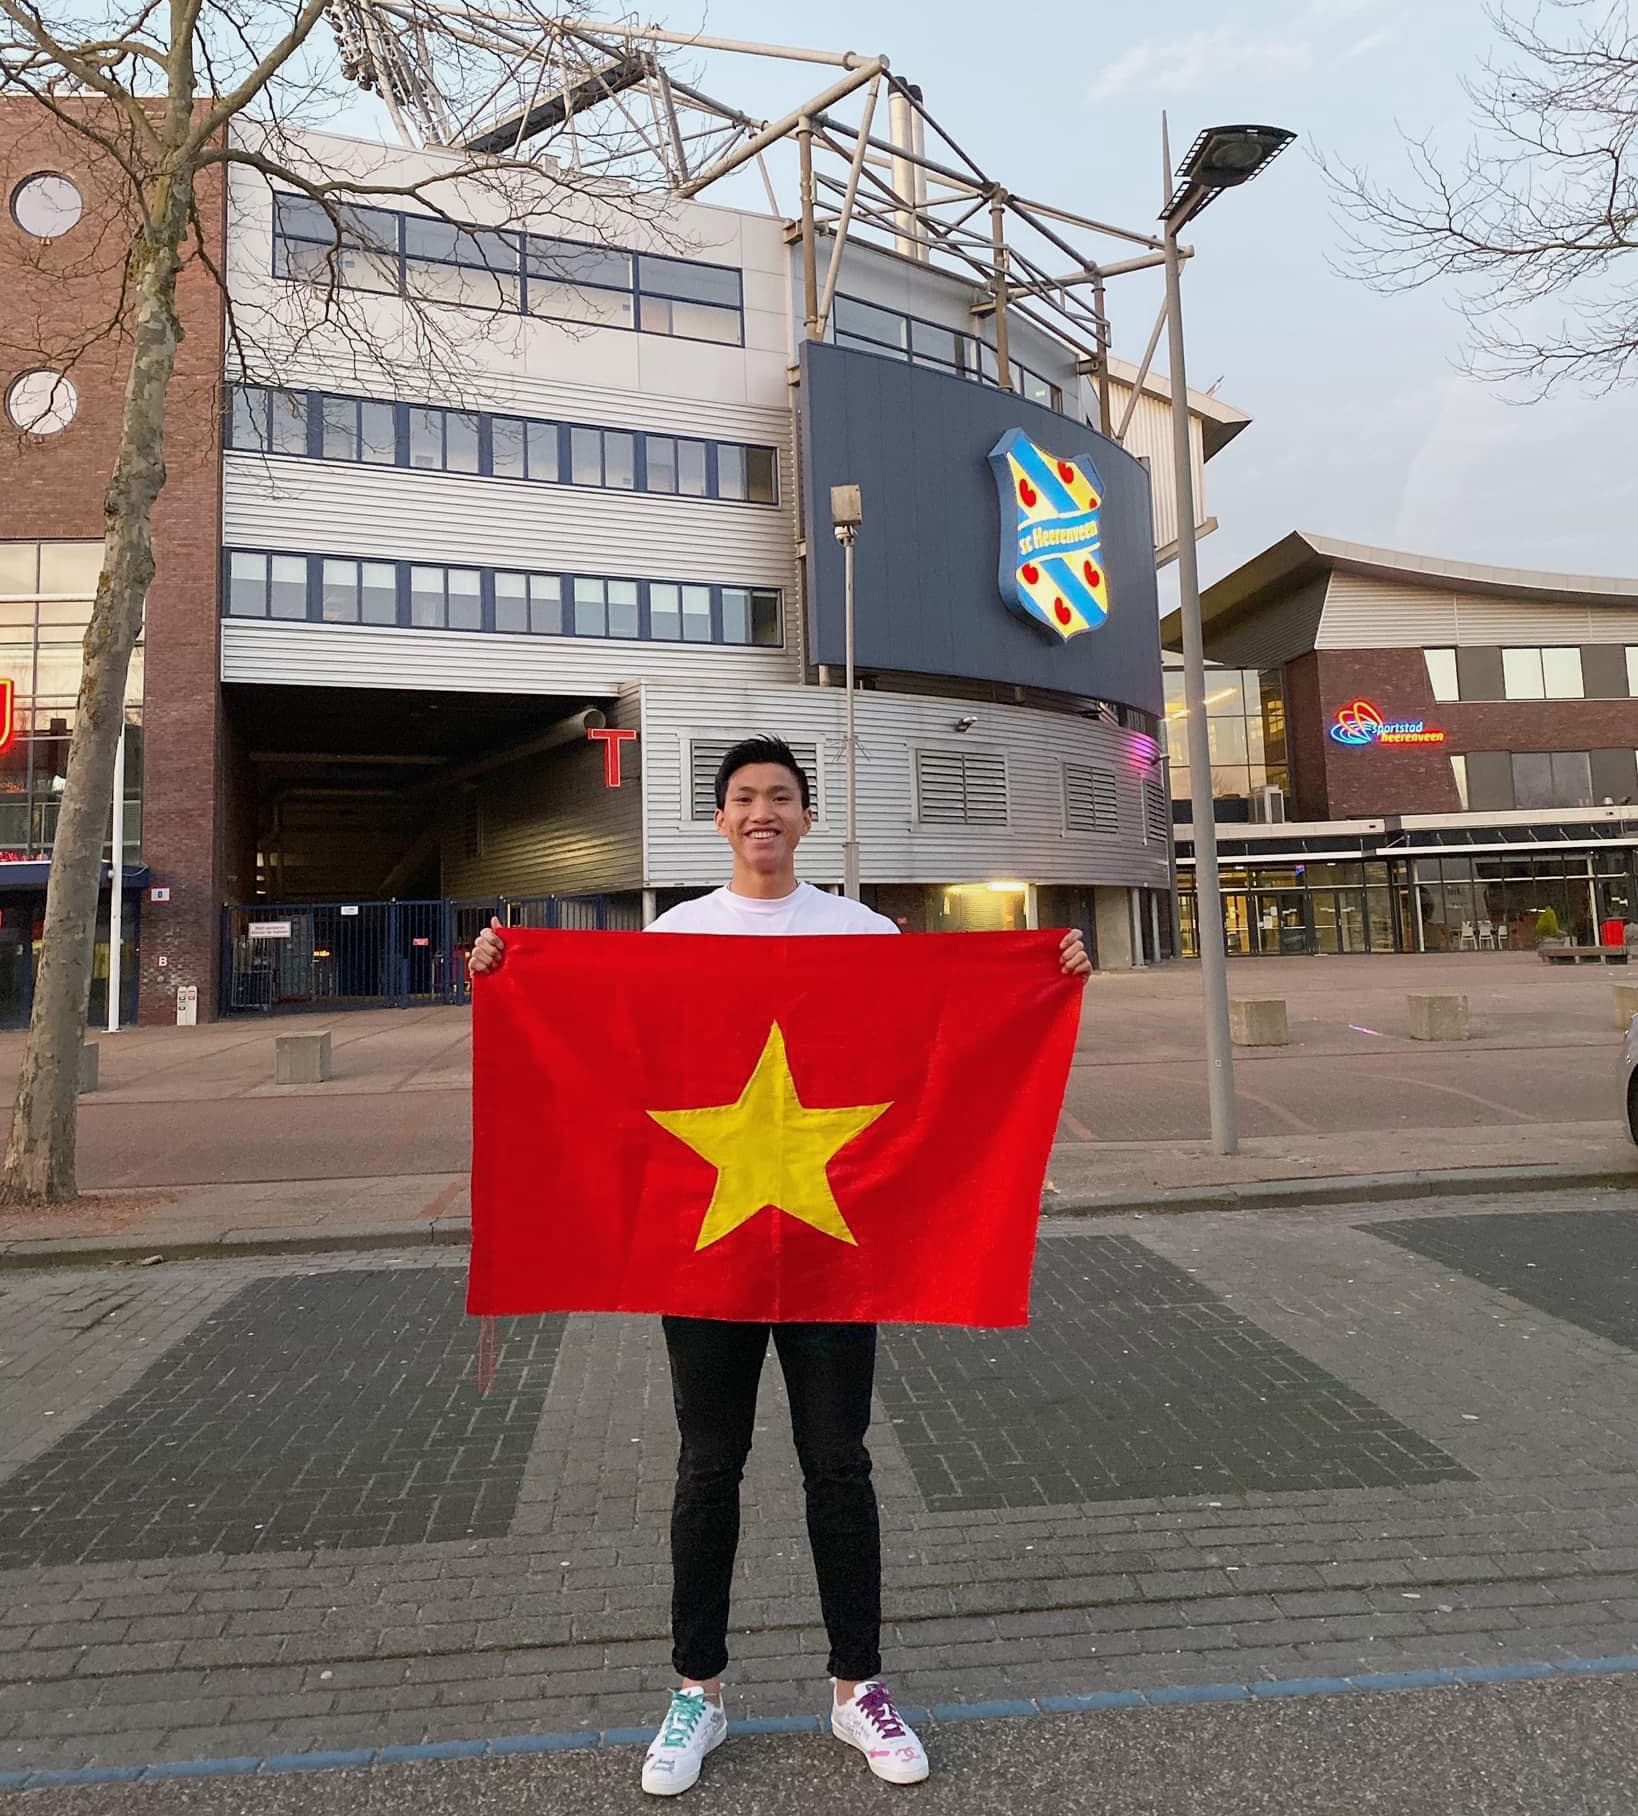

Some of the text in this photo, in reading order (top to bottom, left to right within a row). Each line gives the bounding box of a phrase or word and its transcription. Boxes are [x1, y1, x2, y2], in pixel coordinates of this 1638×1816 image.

[1033, 520, 1098, 549] Heerenveen
[588, 728, 637, 788] T
[158, 956, 168, 967] B
